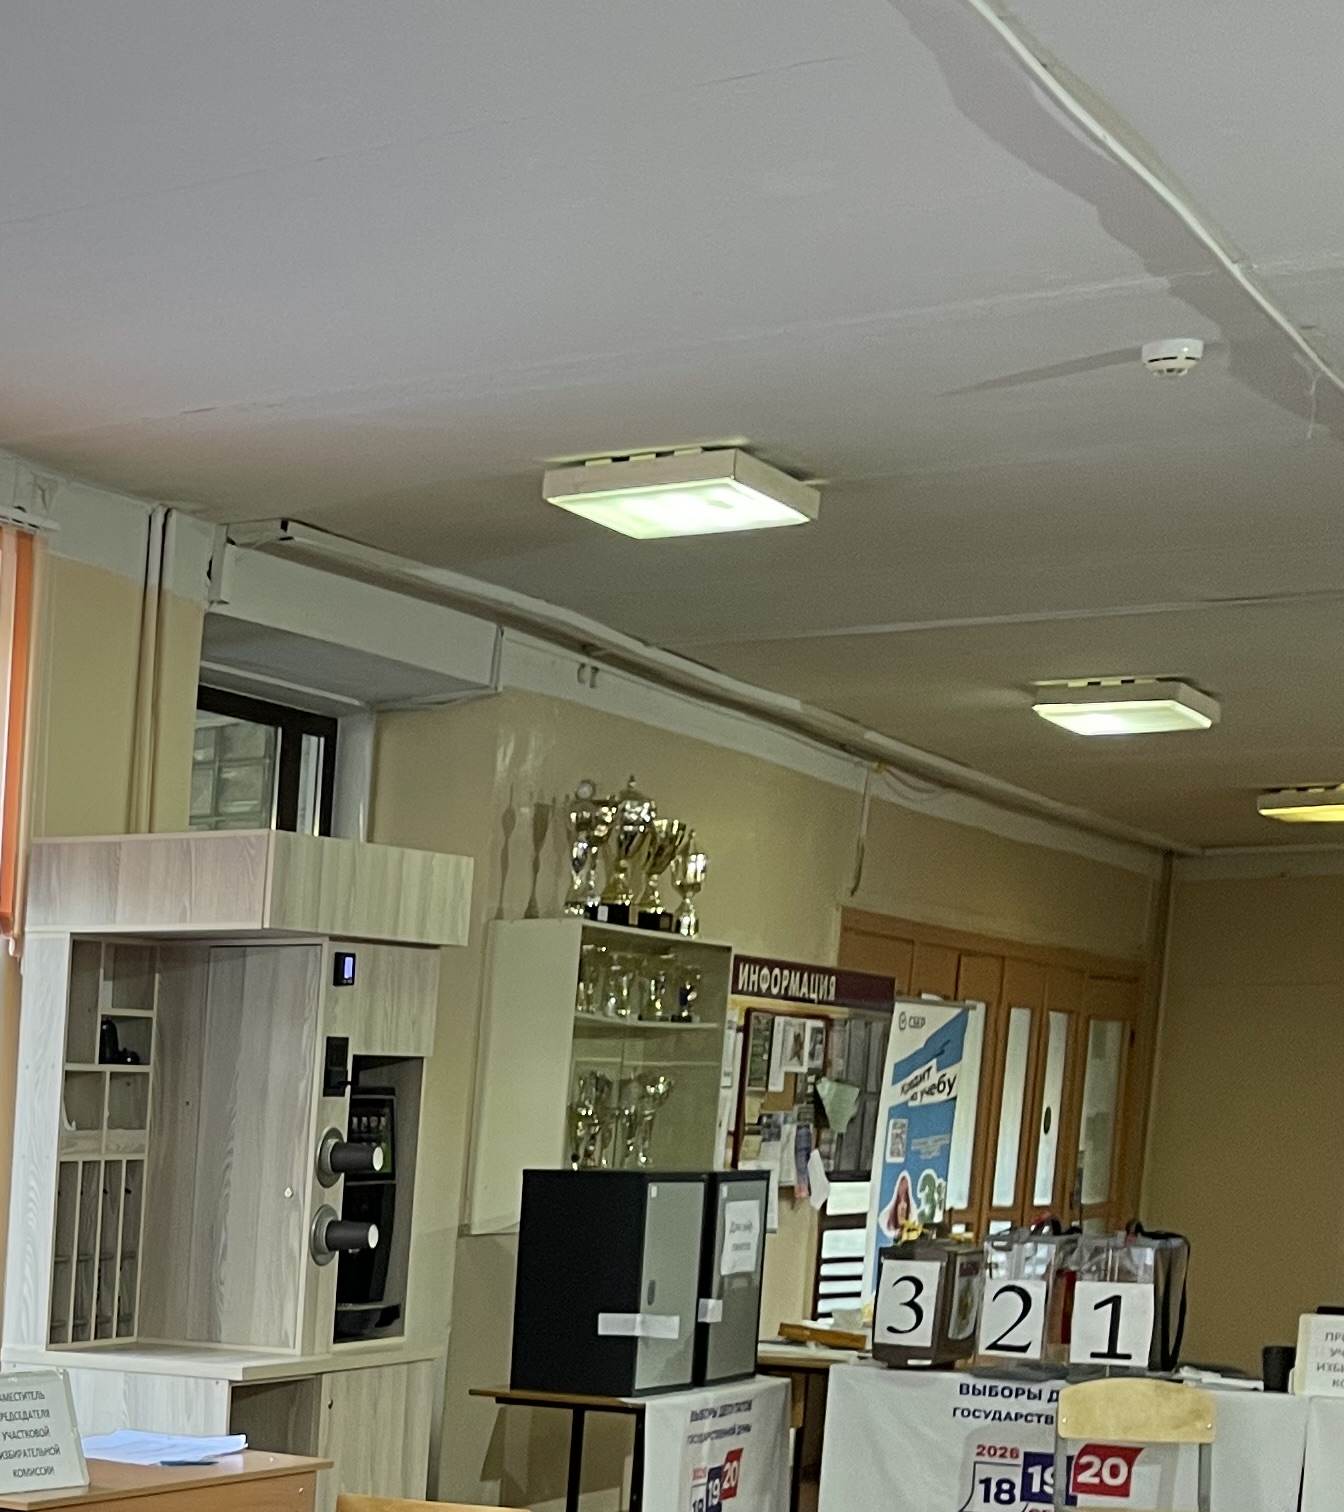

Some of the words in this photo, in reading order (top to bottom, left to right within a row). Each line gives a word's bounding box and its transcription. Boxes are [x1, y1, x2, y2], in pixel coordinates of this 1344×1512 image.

[738, 962, 837, 1004] ИНФОРМАЦИЯ
[886, 1275, 924, 1334] 3
[985, 1284, 1033, 1354] 2
[1090, 1294, 1132, 1360] 1
[959, 1382, 1043, 1402] ВЫБОРЫ
[952, 1406, 1055, 1426] ГОСУДАРСТВ
[12, 1465, 55, 1478] КОМИССИИ
[708, 1478, 721, 1506] 19
[723, 1460, 739, 1491] 20
[978, 1476, 1017, 1506] 18
[1076, 1454, 1129, 1487] 20
